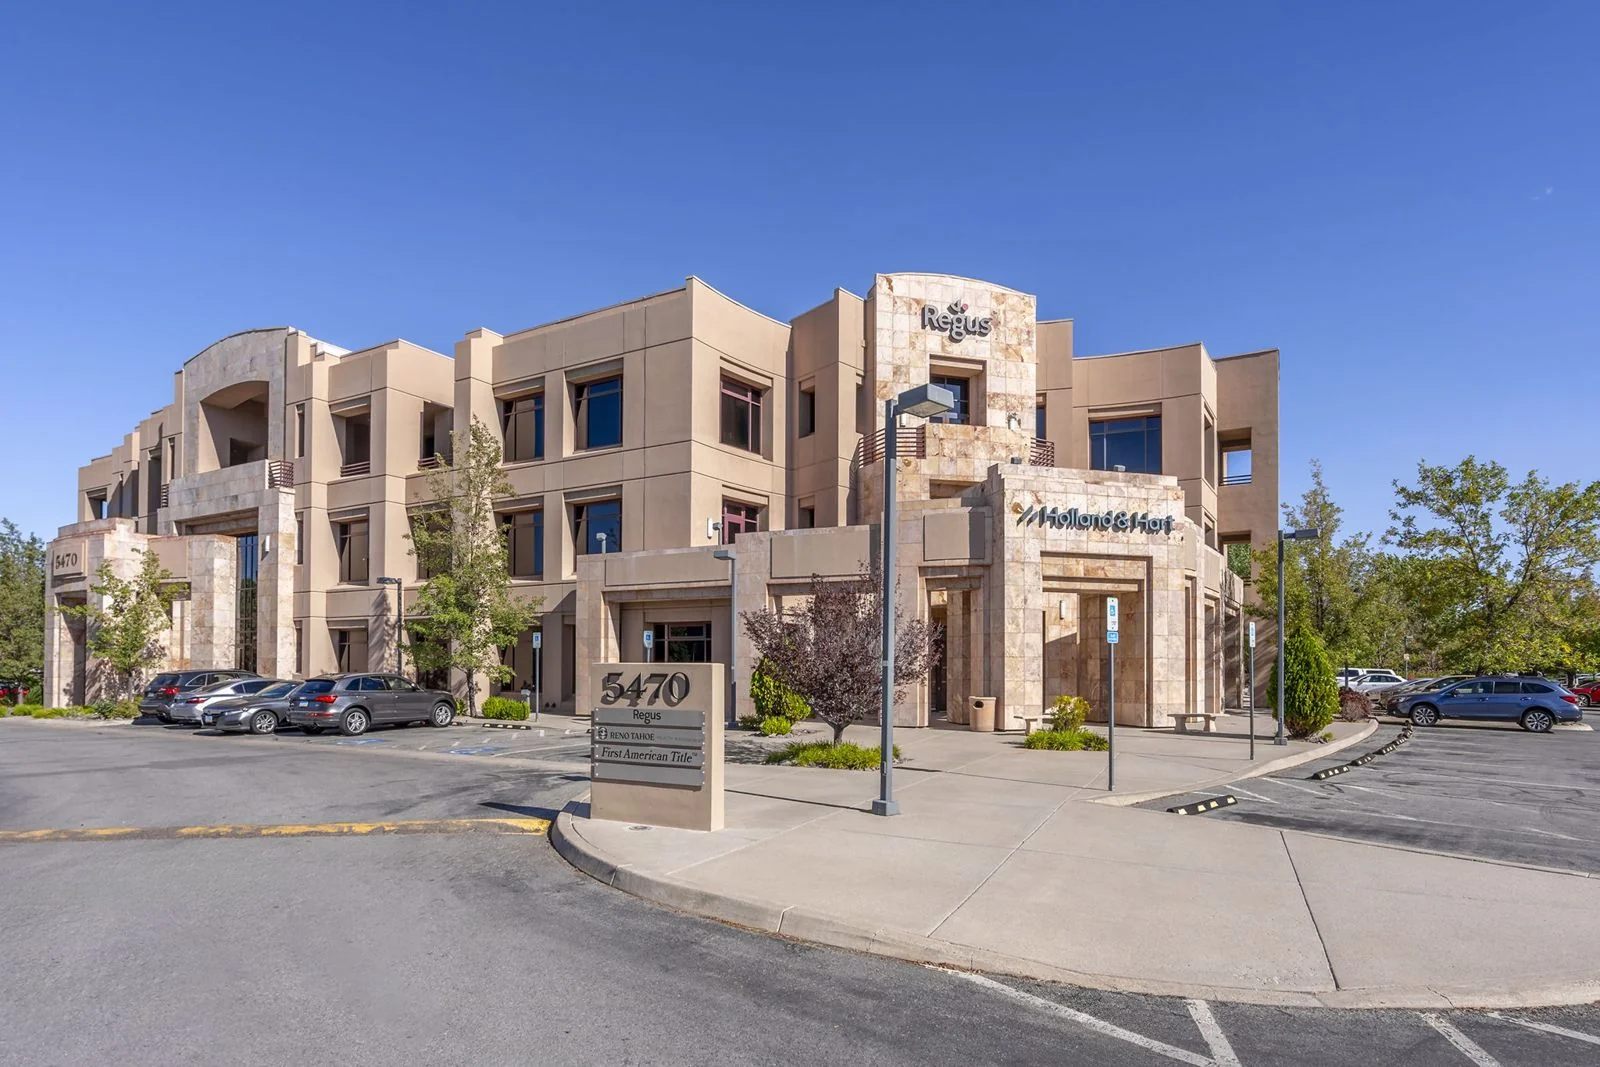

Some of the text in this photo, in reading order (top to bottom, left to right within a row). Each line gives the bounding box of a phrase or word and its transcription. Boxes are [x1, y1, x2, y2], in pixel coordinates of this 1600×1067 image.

[923, 304, 992, 342] Regus
[1041, 506, 1175, 533] Holland & Hart
[55, 553, 78, 569] 5470
[604, 672, 690, 703] 5470
[633, 709, 662, 724] Regus
[610, 732, 630, 740] RENO
[631, 733, 655, 742] TAHOE
[601, 747, 622, 758] First
[623, 748, 668, 761] American
